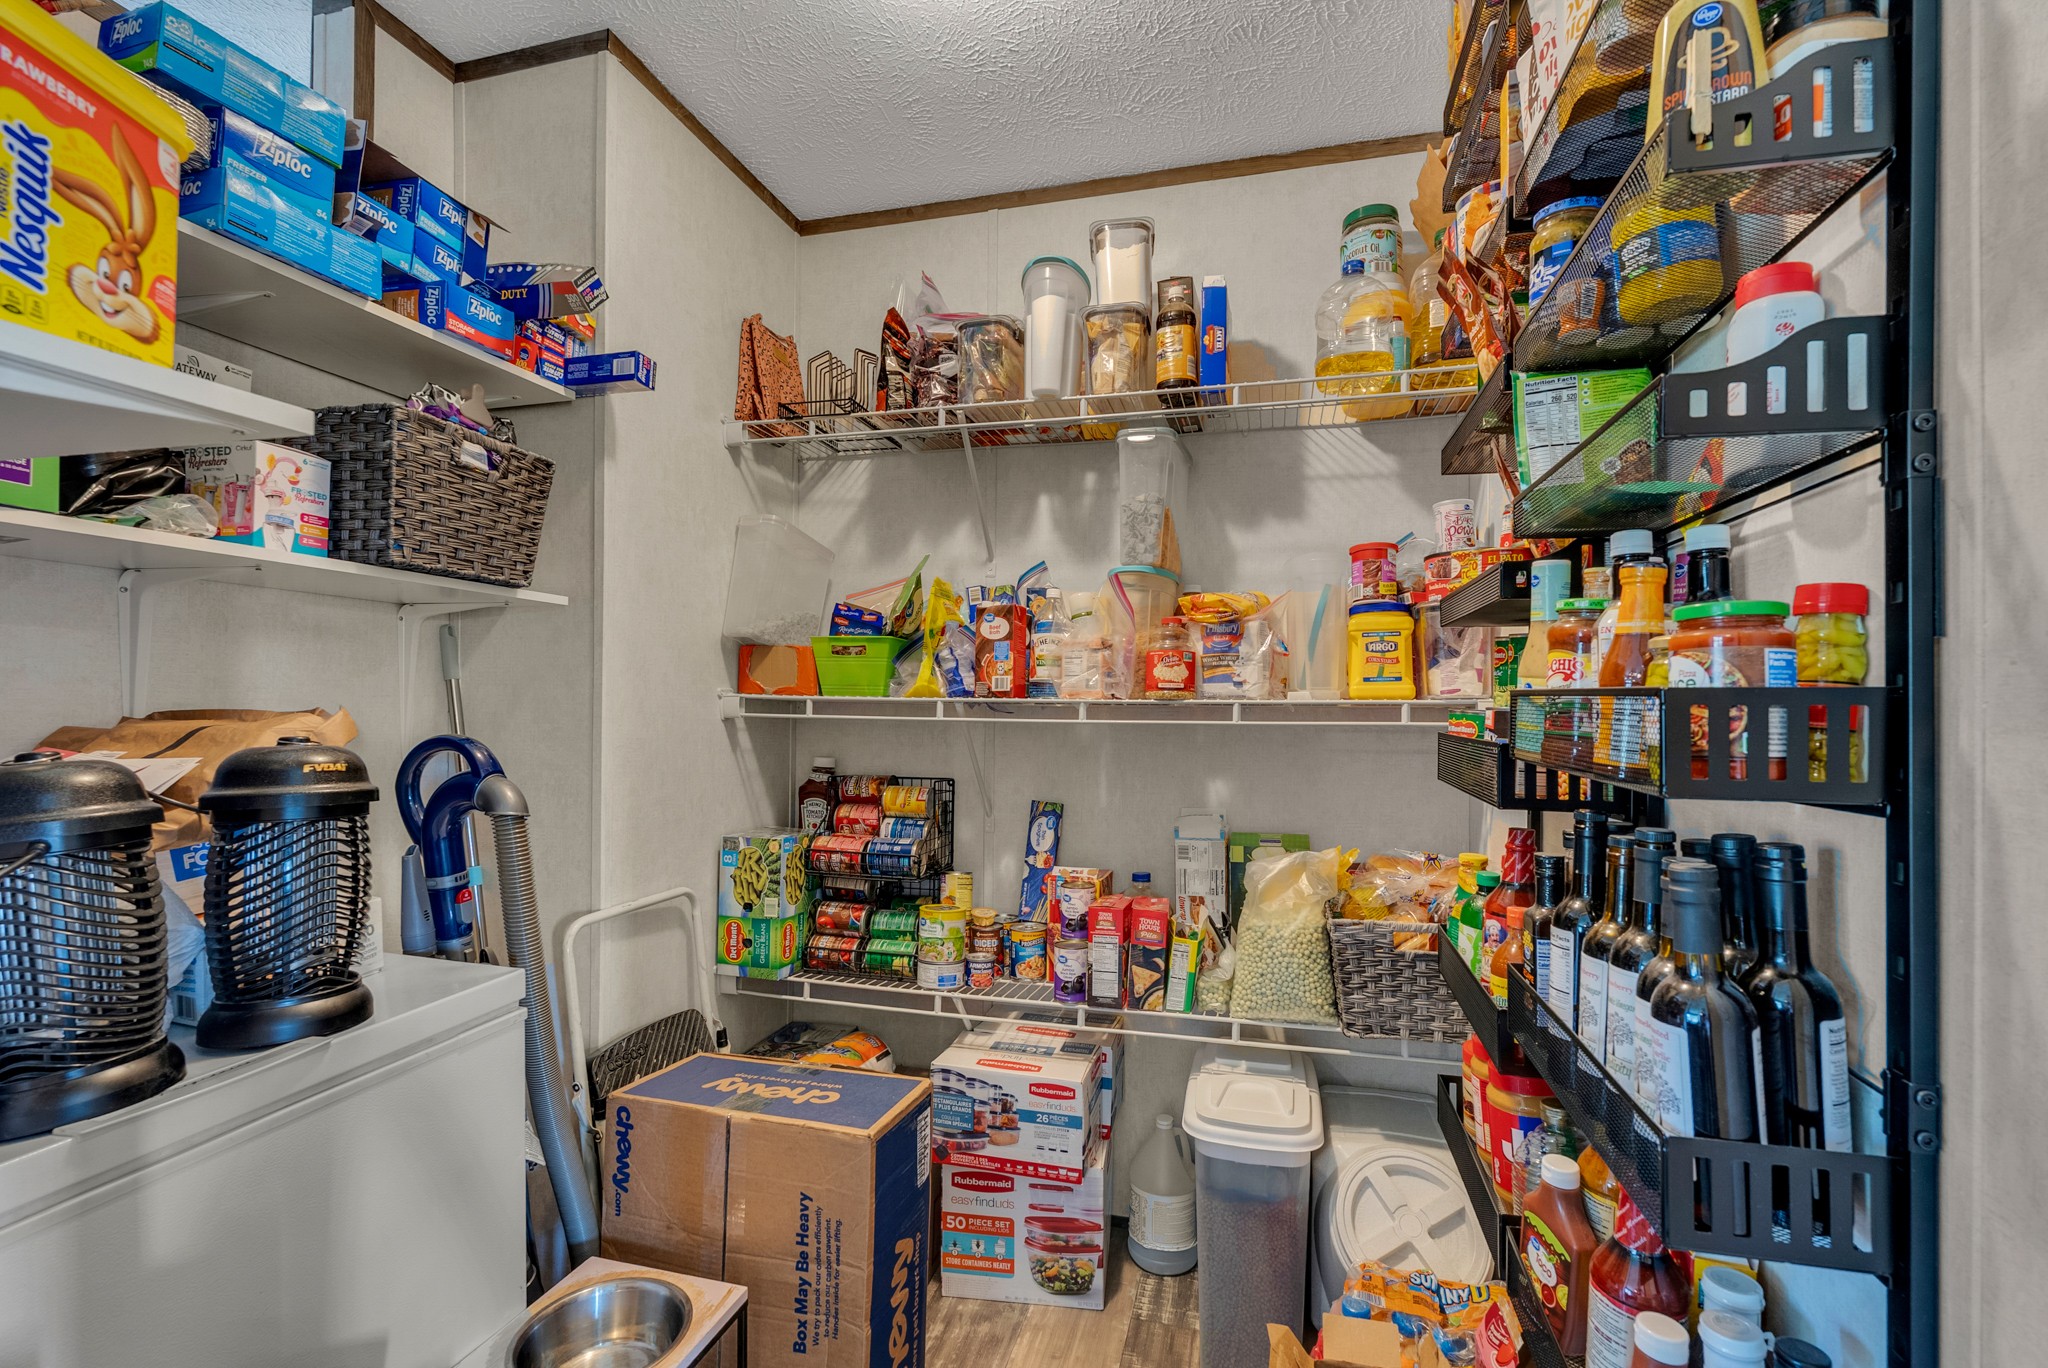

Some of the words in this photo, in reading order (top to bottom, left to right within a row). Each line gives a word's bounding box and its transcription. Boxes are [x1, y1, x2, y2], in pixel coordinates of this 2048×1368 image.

[112, 17, 143, 43] Ziploc
[1712, 70, 1752, 92] ROWN
[257, 134, 312, 180] Ziploc
[226, 157, 268, 184] FREEZER
[0, 118, 65, 293] Nesquik
[315, 208, 328, 221] 54
[1370, 243, 1381, 253] Oil
[500, 288, 528, 300] DUTY
[565, 293, 580, 304] 300
[424, 287, 438, 325] Ziploc
[470, 299, 502, 326] Ziploc
[448, 318, 475, 336] STORAGE
[504, 347, 513, 357] 52
[224, 364, 231, 373] 6
[1525, 379, 1555, 388] Nutrition
[1551, 395, 1563, 403] 260
[188, 456, 228, 471] Refreshers
[303, 458, 309, 466] 6
[294, 493, 325, 507] Refreshers
[1487, 555, 1498, 563] EL
[1500, 553, 1524, 562] PATO
[1429, 583, 1450, 591] baking
[1370, 642, 1395, 651] ARGO
[1678, 669, 1697, 678] Pizza
[723, 854, 733, 863] 8
[1139, 917, 1161, 926] TOWN
[729, 922, 738, 945] Monte
[1139, 924, 1161, 933] HOUSE
[1140, 930, 1158, 940] Pita
[974, 939, 998, 947] DICED
[729, 946, 738, 959] Del
[735, 1072, 760, 1080] shop
[761, 1075, 790, 1083] lovers
[701, 1076, 841, 1105] chewy
[811, 1081, 843, 1089] where
[1031, 1086, 1074, 1097] Rubbermaid
[1036, 1113, 1050, 1123] 26
[612, 1105, 635, 1217] chewy.com
[954, 1176, 1012, 1189] Rubbermaid
[795, 1191, 814, 1247] Heavy
[946, 1215, 966, 1230] 50
[968, 1218, 993, 1227] PIECE
[994, 1220, 1011, 1228] SET
[814, 1206, 823, 1246] efficiently
[834, 1218, 843, 1243] lifting.
[968, 1225, 997, 1233] INCLUDING
[825, 1217, 833, 1255] pawprint.
[795, 1250, 809, 1273] Be
[945, 1257, 961, 1265] STORE
[961, 1259, 993, 1269] CONTAINERS
[992, 1260, 1011, 1270] NEATLY
[824, 1256, 832, 1283] carbon
[794, 1276, 812, 1316] May
[814, 1287, 822, 1307] pack
[832, 1281, 840, 1306] inside
[813, 1319, 822, 1330] try
[832, 1307, 840, 1340] Handles
[792, 1318, 808, 1355] Box
[812, 1331, 820, 1347] We
